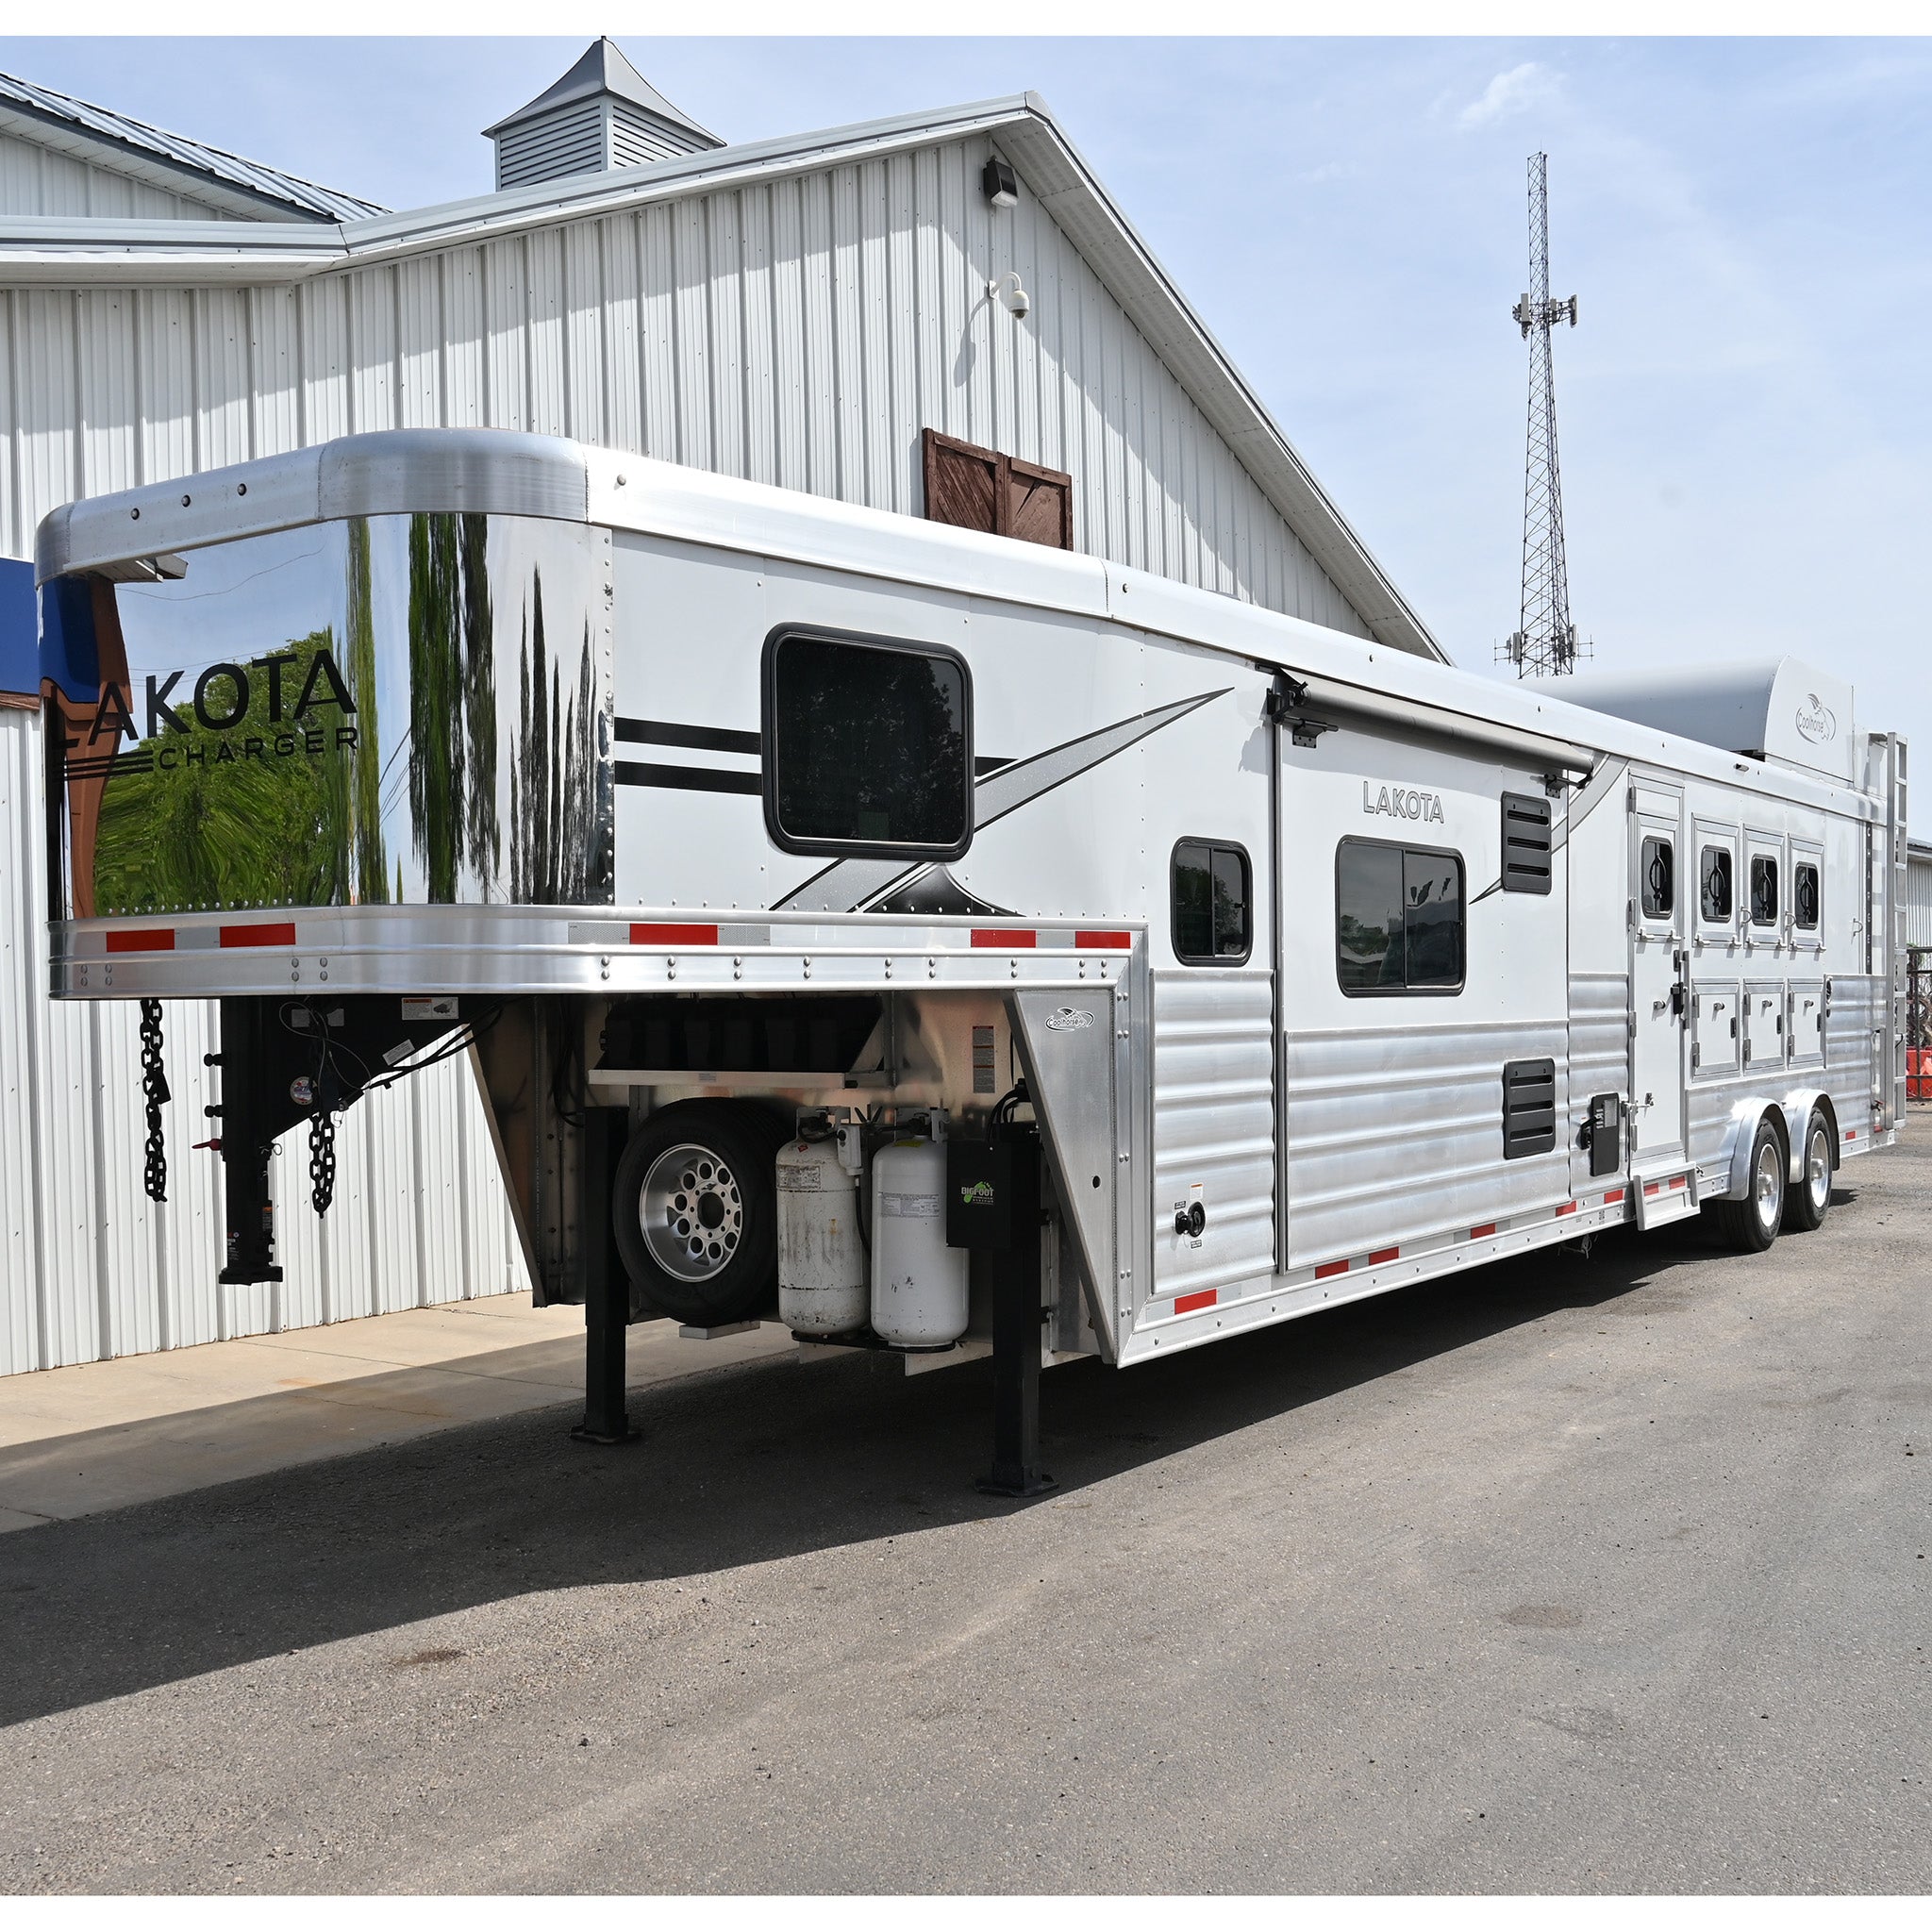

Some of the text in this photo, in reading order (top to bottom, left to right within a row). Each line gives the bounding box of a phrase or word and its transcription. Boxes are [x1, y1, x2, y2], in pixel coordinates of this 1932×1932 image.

[1798, 712, 1824, 734] Coolhorse
[159, 727, 358, 770] CHARGER
[1363, 780, 1444, 824] LAKOTA
[960, 1186, 994, 1197] BIGFOOT
